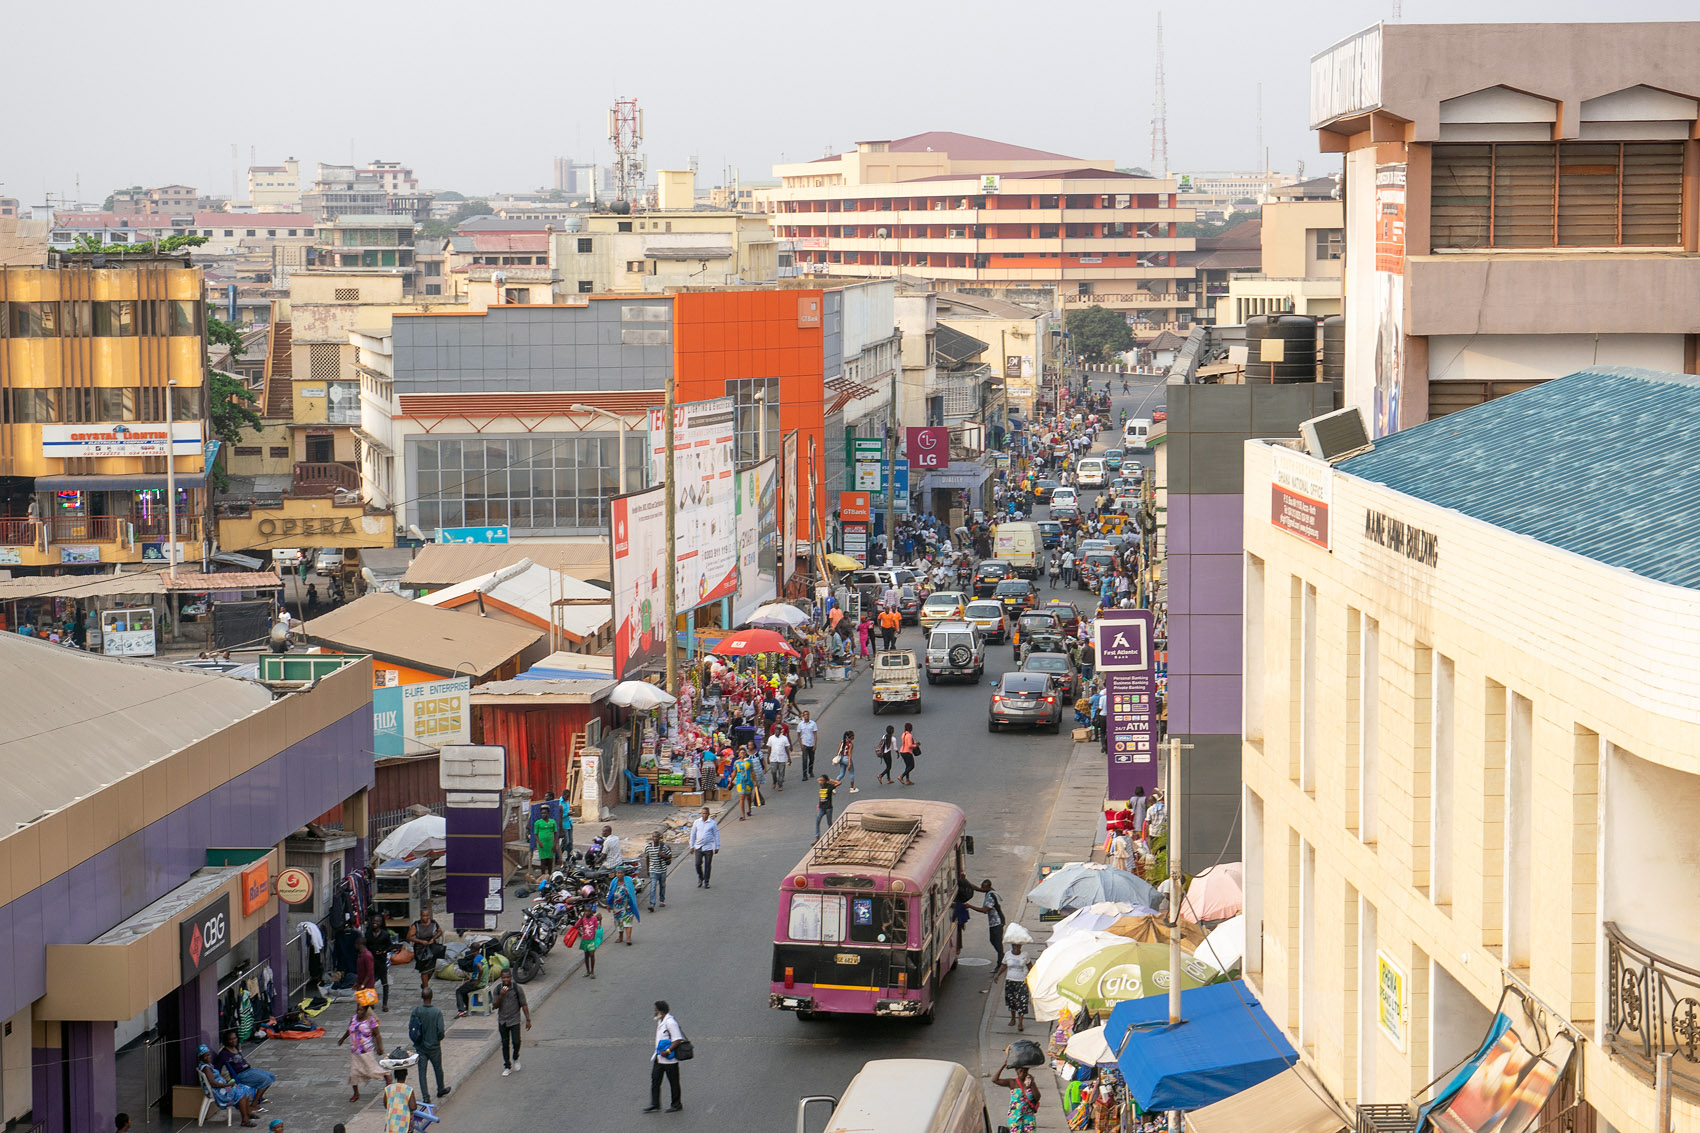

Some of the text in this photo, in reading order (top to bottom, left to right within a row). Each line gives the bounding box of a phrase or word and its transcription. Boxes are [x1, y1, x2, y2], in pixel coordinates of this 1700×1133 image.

[70, 432, 117, 440] CRYSTAL
[919, 454, 937, 465] LG
[258, 516, 356, 537] OPERA
[1406, 524, 1438, 568] BUILDING
[405, 681, 468, 698] E-LIFE ENTERPRISE
[1126, 722, 1149, 730] ATM
[204, 912, 225, 948] CBG
[1107, 974, 1140, 996] glo
